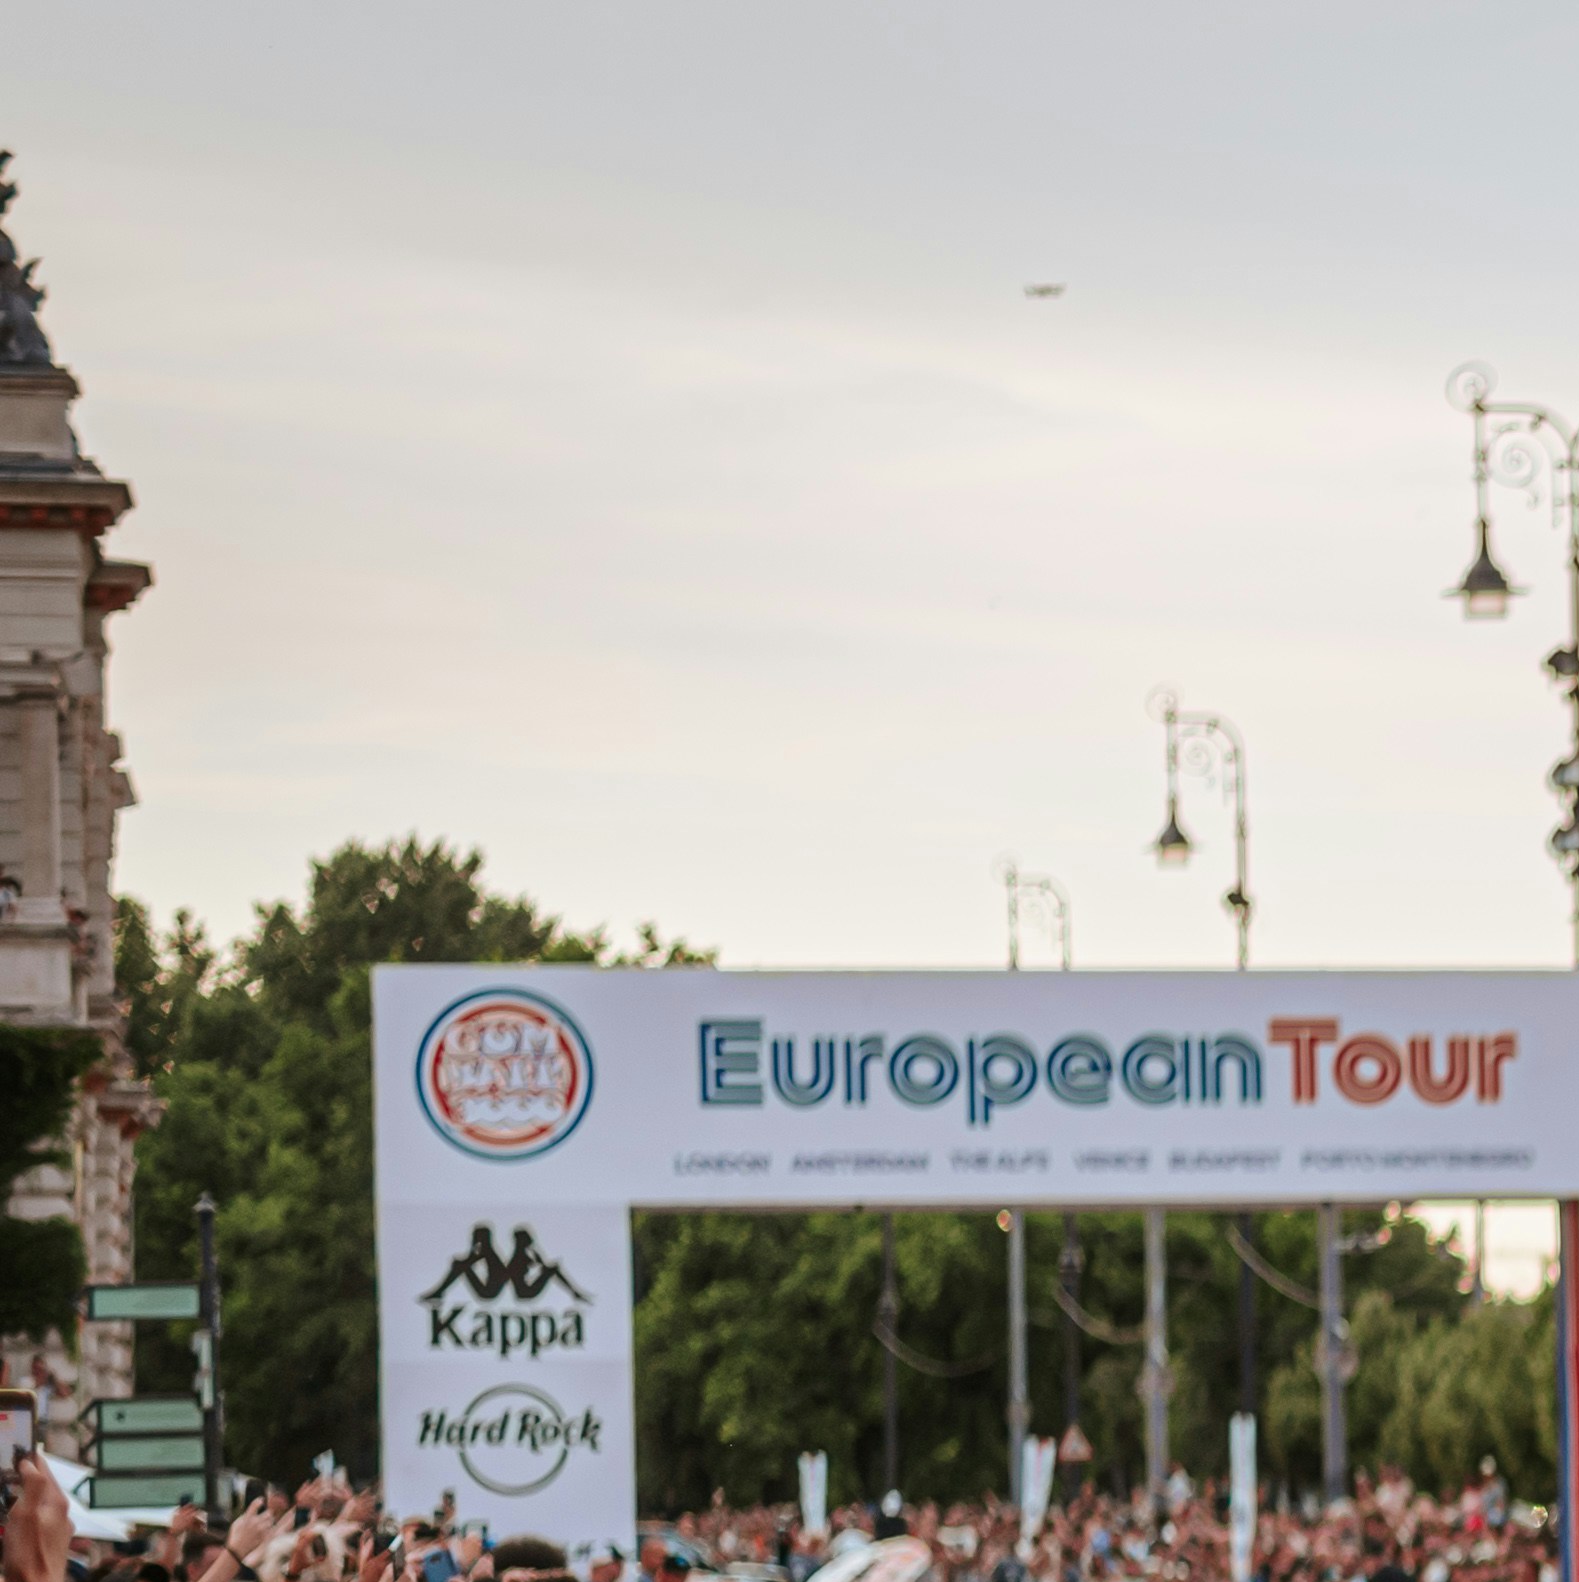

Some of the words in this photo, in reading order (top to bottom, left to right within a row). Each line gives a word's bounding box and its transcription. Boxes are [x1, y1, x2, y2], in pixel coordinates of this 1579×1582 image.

[429, 1304, 584, 1359] Kappa
[417, 1408, 511, 1447] Hard
[518, 1407, 602, 1454] Rock
